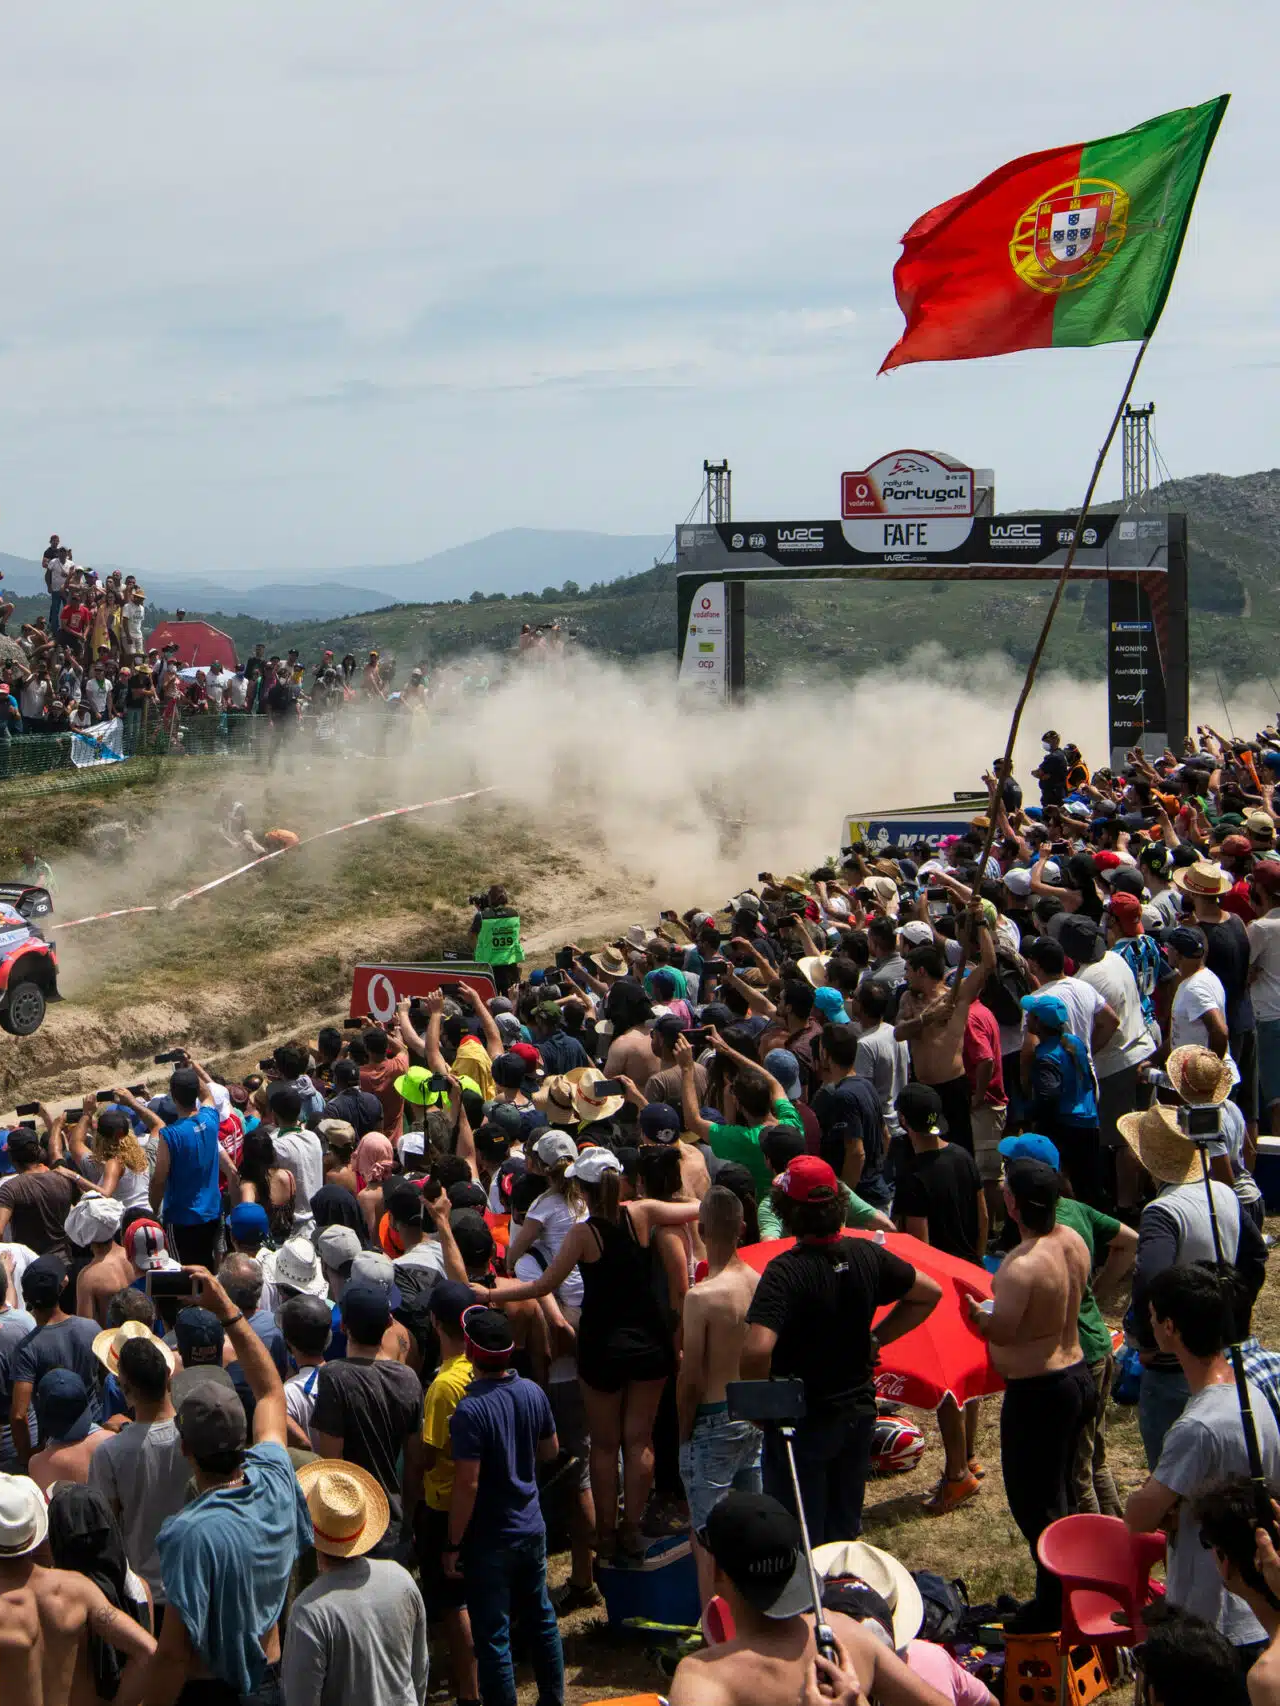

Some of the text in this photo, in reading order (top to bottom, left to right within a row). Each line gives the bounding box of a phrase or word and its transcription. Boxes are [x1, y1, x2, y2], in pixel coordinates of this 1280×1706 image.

[882, 486, 967, 502] Portugal
[777, 528, 824, 541] WRC
[883, 523, 928, 546] FAFE
[989, 524, 1042, 537] WRC
[693, 610, 720, 618] vodafone
[698, 660, 714, 669] acp
[492, 936, 514, 948] 039
